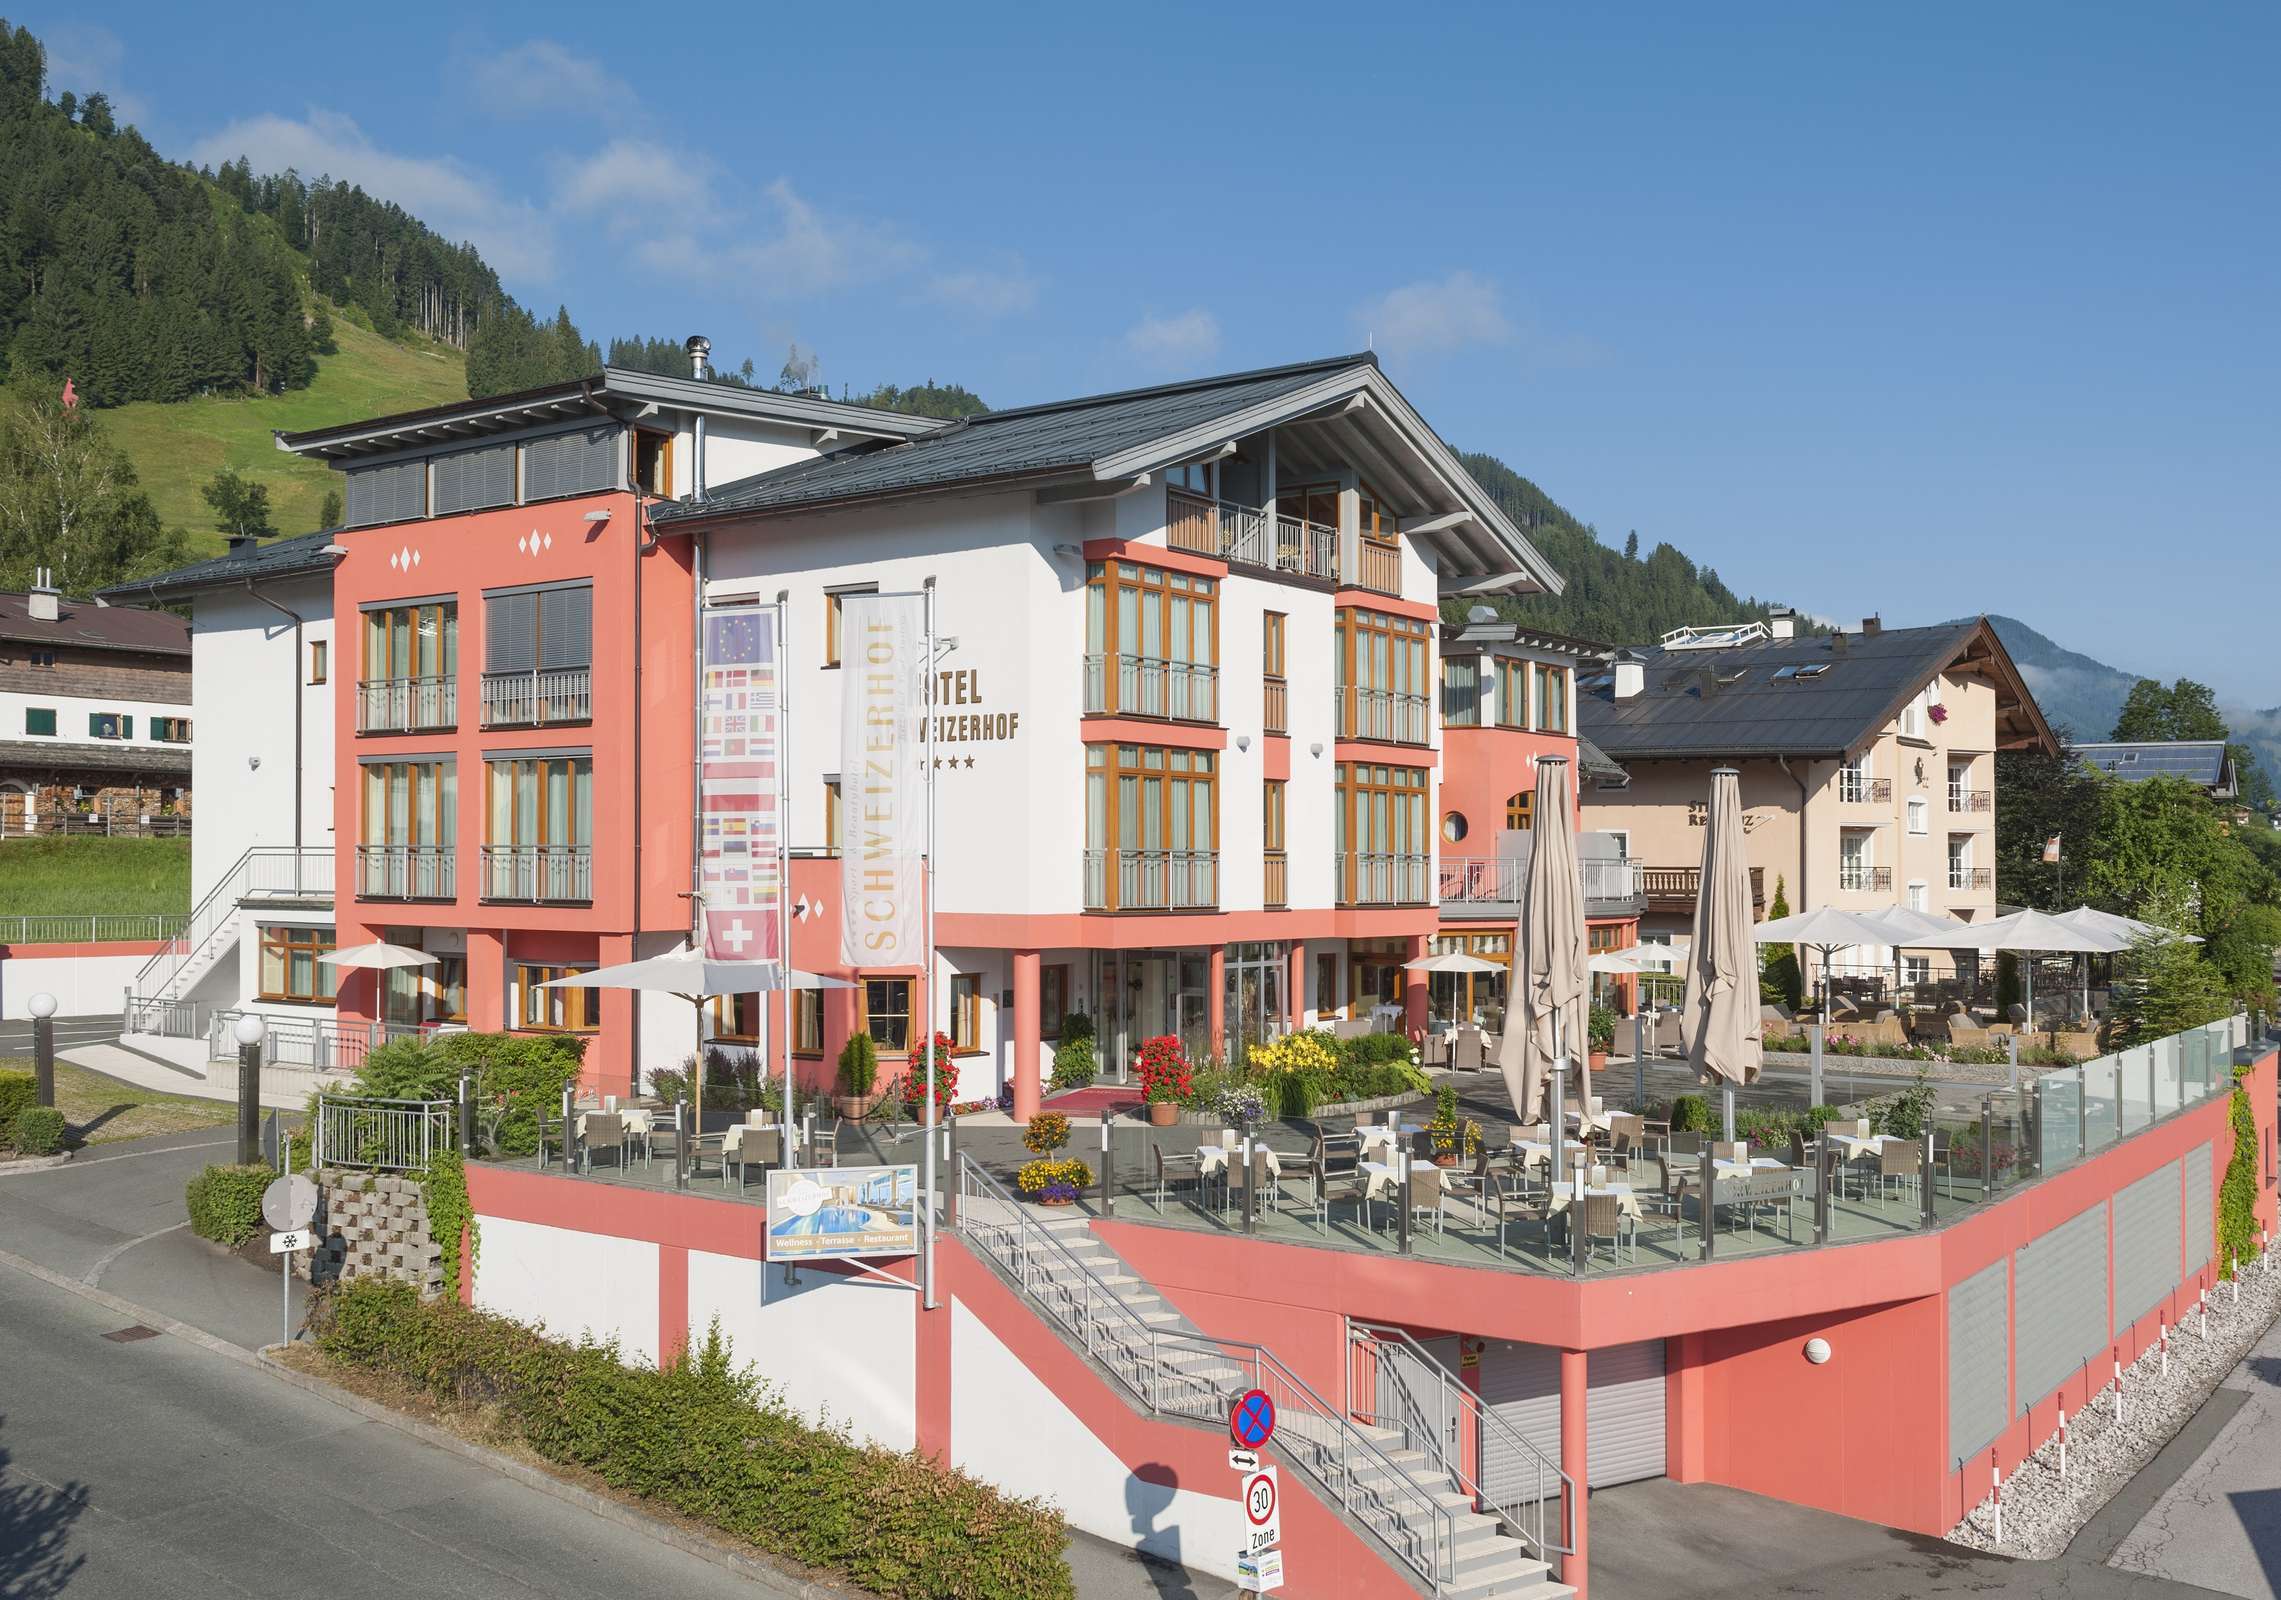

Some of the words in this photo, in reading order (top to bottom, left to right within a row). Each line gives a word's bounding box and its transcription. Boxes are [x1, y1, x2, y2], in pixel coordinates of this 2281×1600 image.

[919, 669, 982, 706] OTEL
[864, 615, 897, 950] SCHWEIZERHOF
[776, 1239, 813, 1248] Wellness
[821, 1236, 855, 1246] Terrasse
[863, 1233, 909, 1244] Restaurant
[1253, 1488, 1268, 1512] 30
[1252, 1529, 1275, 1549] Zone
